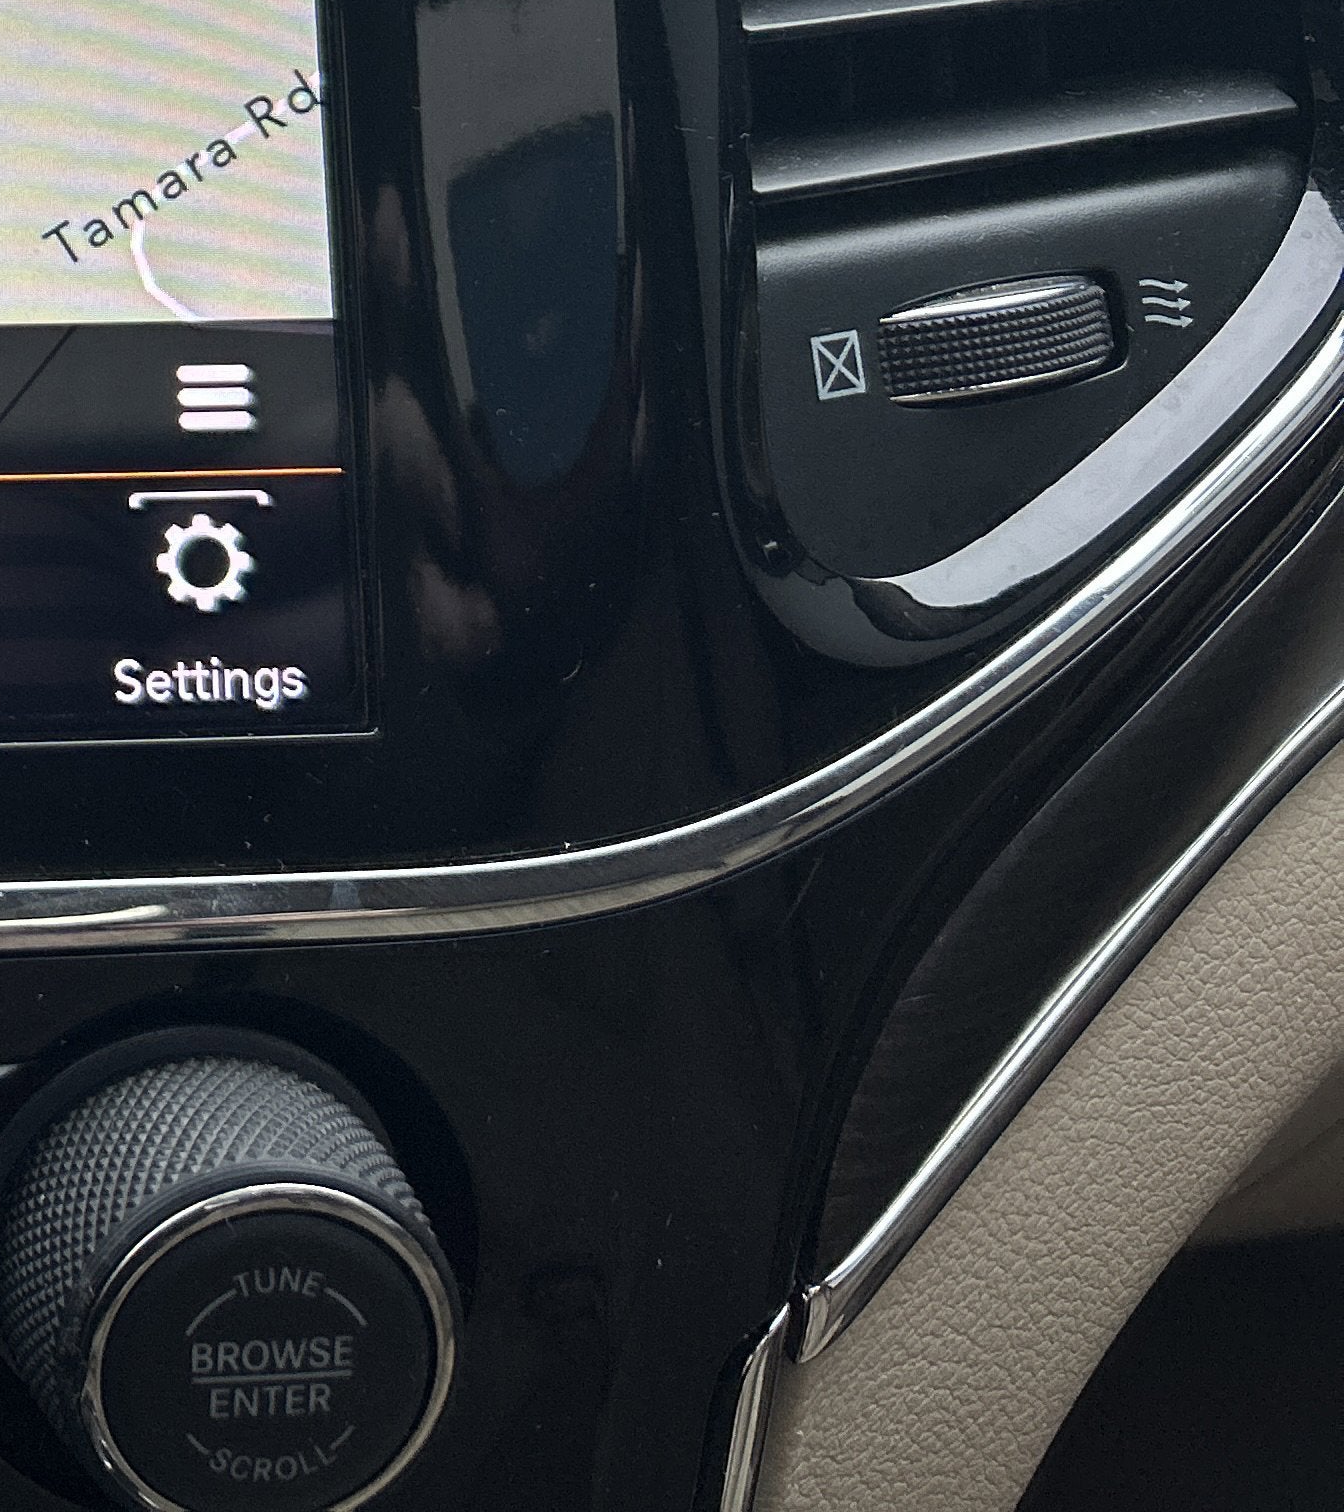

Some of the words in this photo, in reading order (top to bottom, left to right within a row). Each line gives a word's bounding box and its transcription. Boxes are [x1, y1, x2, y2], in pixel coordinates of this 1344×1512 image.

[42, 136, 237, 266] Tamara
[244, 69, 322, 140] Rd
[114, 657, 308, 708] Settings
[233, 1265, 327, 1300] TUNE
[190, 1336, 355, 1374] BROWSE
[210, 1382, 332, 1419] ENTER
[208, 1442, 332, 1482] SCROLL
